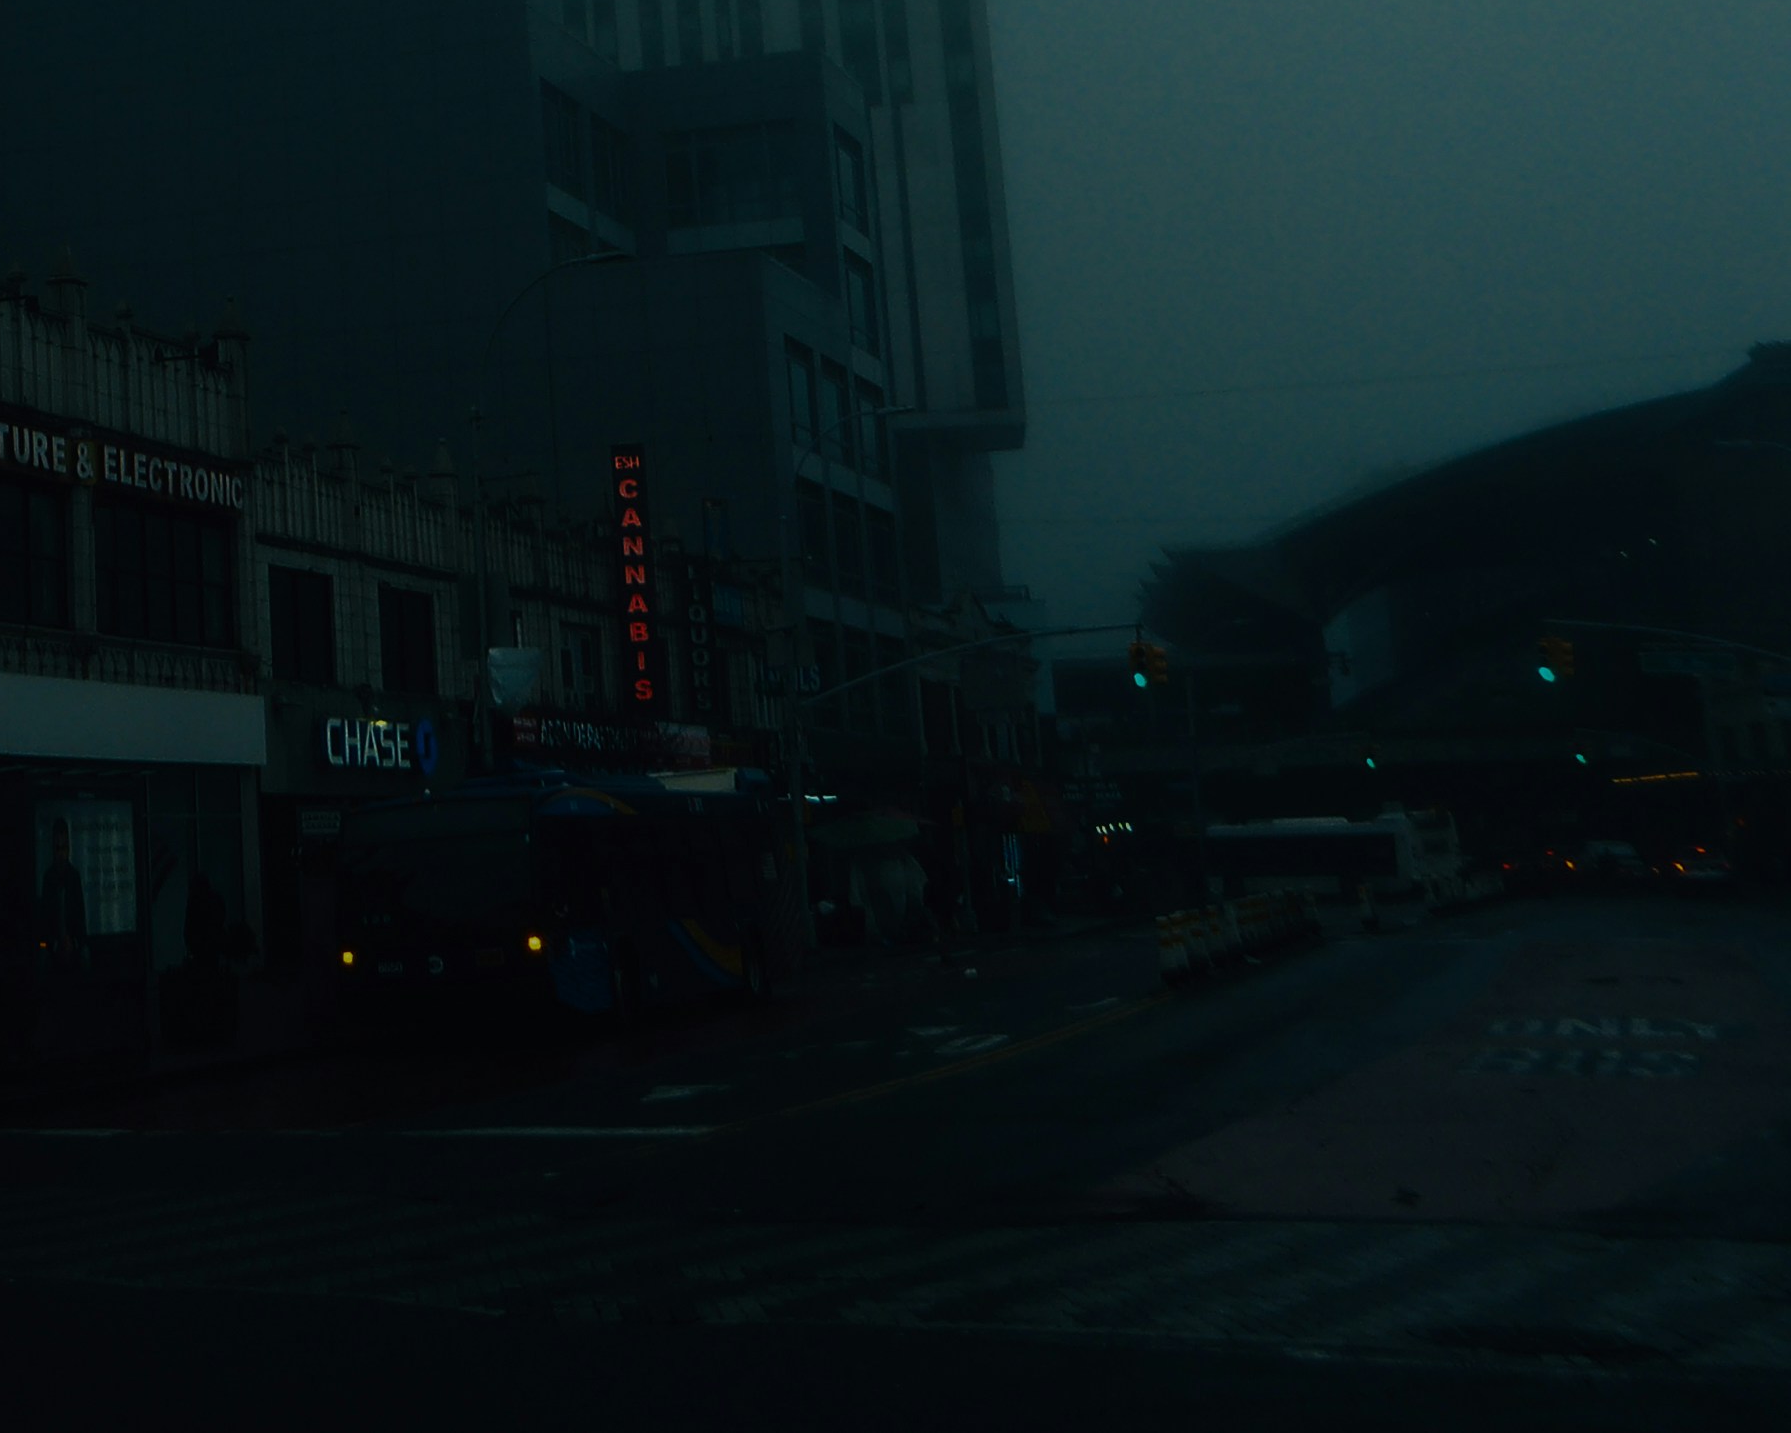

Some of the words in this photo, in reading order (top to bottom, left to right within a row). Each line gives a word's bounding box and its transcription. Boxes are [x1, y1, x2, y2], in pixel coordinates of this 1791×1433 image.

[75, 441, 95, 480] &
[103, 443, 244, 510] ELECTRONIC
[617, 478, 655, 702] CANNABIS
[326, 717, 412, 768] CHASE
